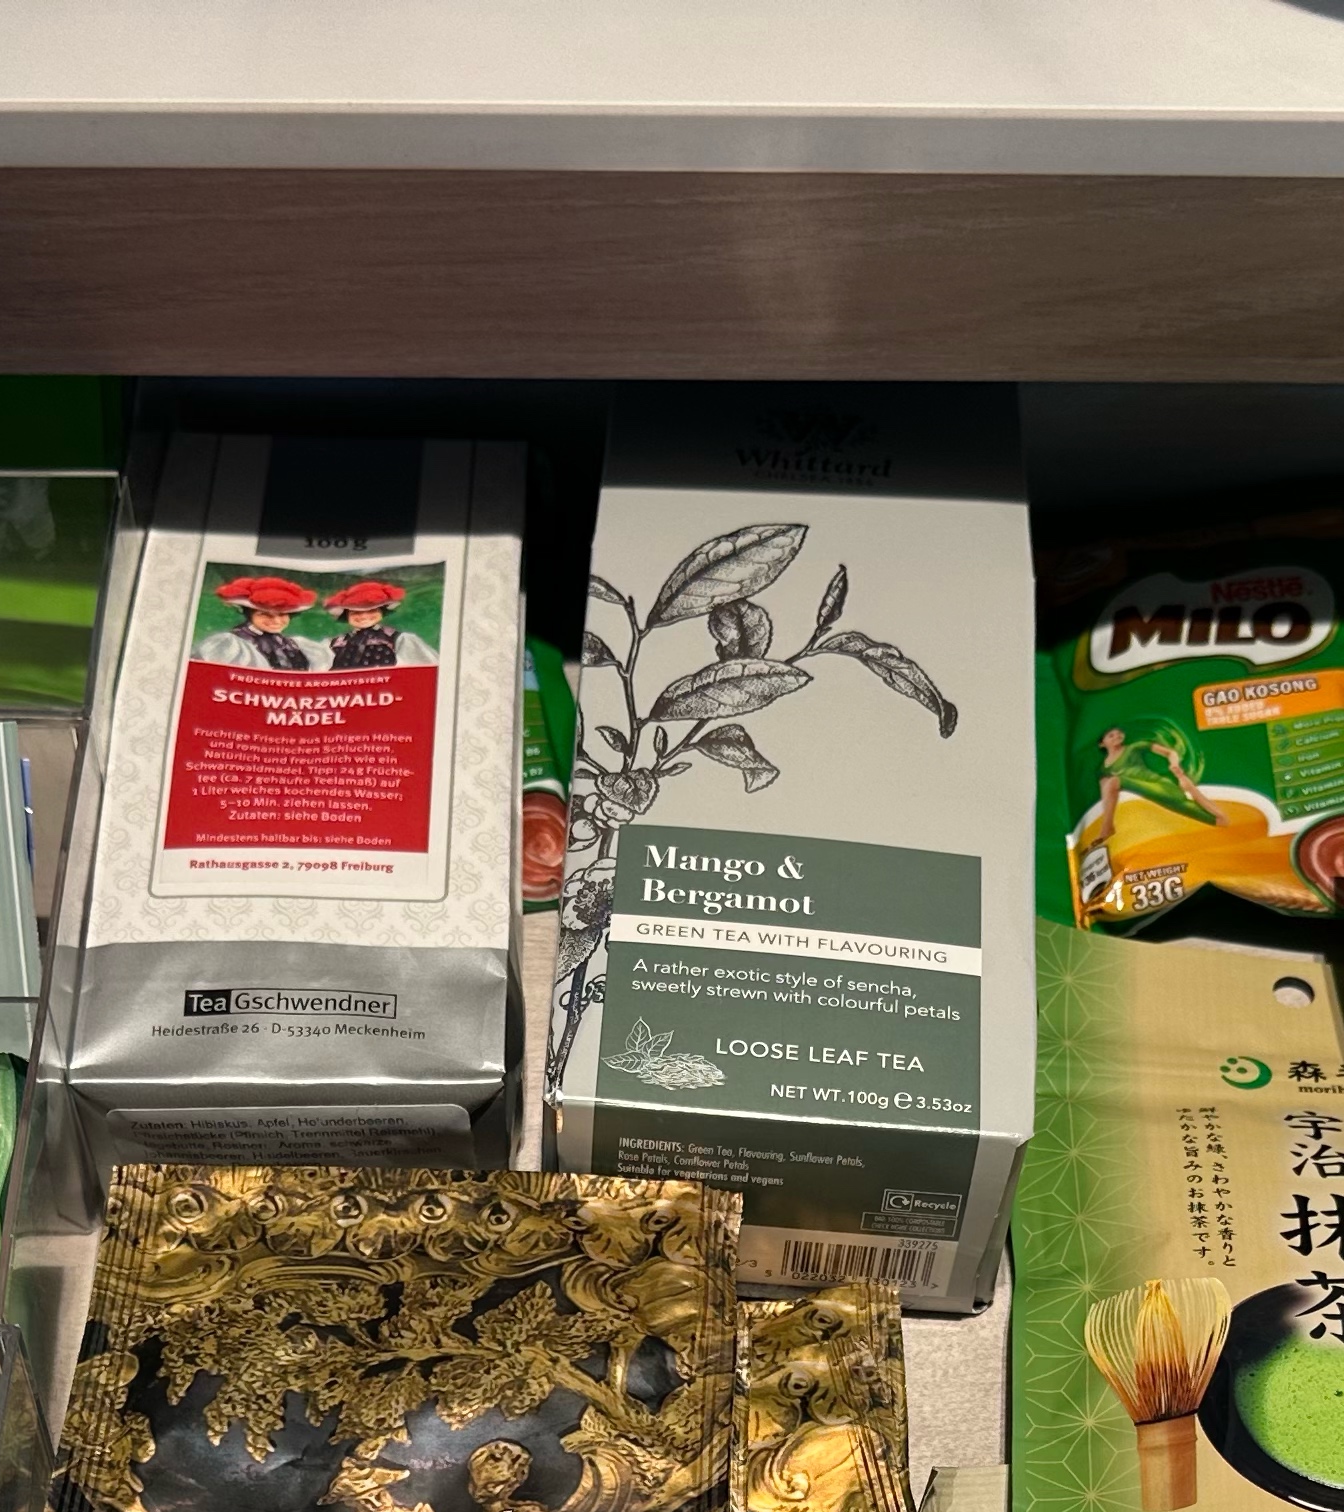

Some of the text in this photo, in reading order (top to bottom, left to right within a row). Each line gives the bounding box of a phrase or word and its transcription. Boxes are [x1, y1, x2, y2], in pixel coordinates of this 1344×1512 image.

[1109, 605, 1312, 660] MILO
[213, 690, 403, 710] SCHWARZWALD-
[1203, 678, 1318, 708] GAO KOSONG
[266, 711, 346, 726] MÄDEL
[189, 860, 395, 873] Rathausgasse 79098 Freiburg
[644, 844, 805, 884] Mango &
[641, 878, 817, 917] Bergamot
[1131, 877, 1185, 910] 33G
[636, 922, 949, 965] GREEN TEA WITH FLAVOURING
[632, 957, 918, 1000] A rather exotic style of sencha,
[189, 992, 392, 1017] Tea Gschwendner
[631, 978, 962, 1023] sweetly strewn with colourful petals
[151, 1022, 426, 1042] Heidestraße 26 D-53340 Meckenheim
[714, 1038, 926, 1074] LOOSE LEAF TEA
[770, 1083, 973, 1115] NET 3.53oz
[618, 1137, 834, 1166] INGREDIENTS: Green Sunflower
[913, 1199, 957, 1211] Recycle
